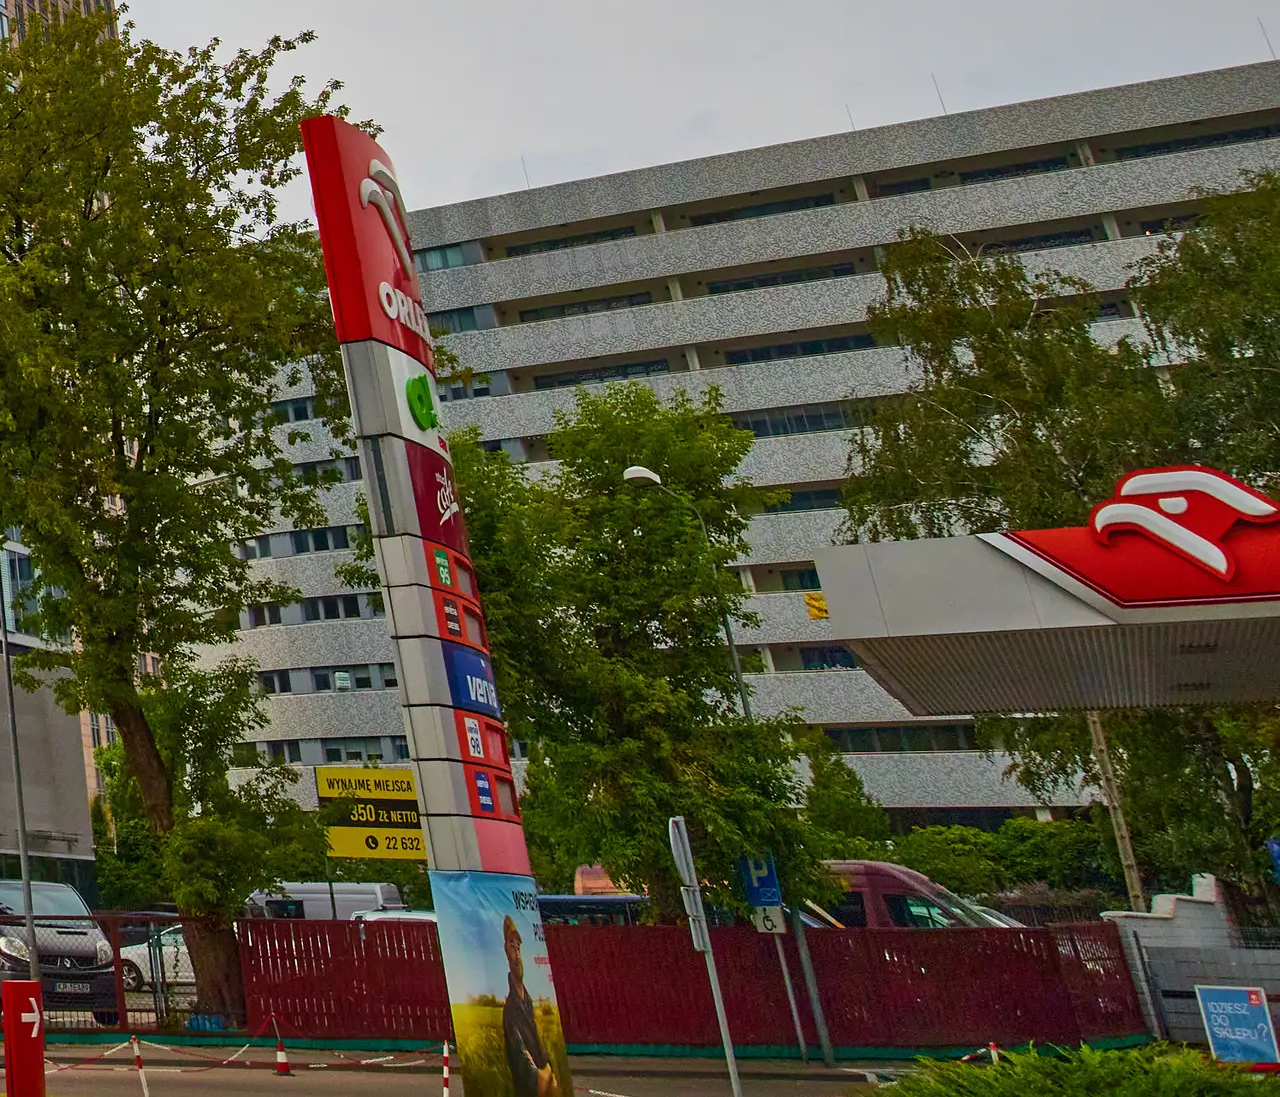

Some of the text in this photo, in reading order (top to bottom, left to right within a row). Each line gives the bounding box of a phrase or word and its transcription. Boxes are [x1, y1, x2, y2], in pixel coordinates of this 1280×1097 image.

[378, 281, 433, 346] ORLE
[439, 566, 451, 585] 95
[470, 735, 482, 755] 98
[326, 778, 413, 793] WYNAJMĘ MIEJSCA
[391, 810, 418, 823] NETTO
[385, 836, 421, 851] 22 632
[1208, 1001, 1250, 1015] IDZIESZ
[1211, 1014, 1229, 1026] DO
